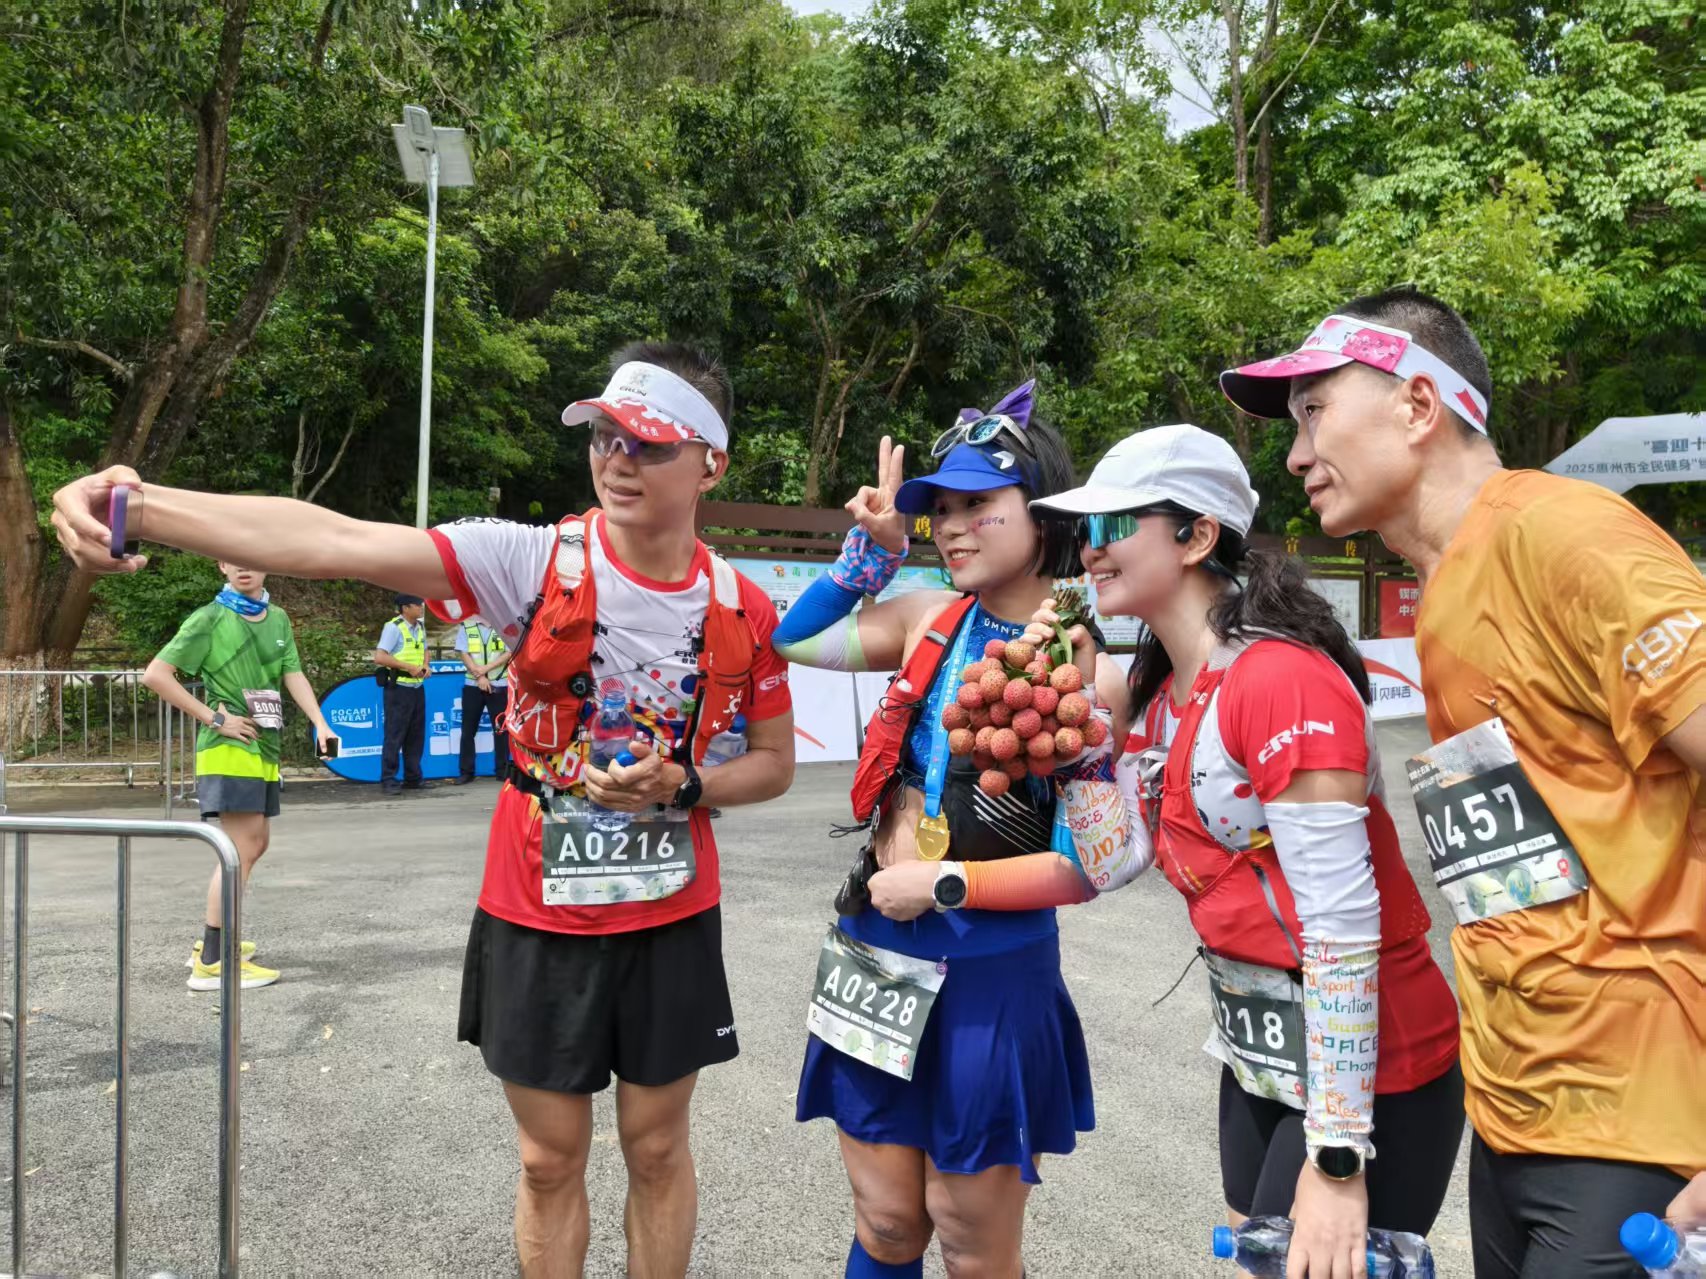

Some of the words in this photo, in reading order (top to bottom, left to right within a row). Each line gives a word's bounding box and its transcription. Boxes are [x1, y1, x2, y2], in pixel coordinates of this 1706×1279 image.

[331, 707, 371, 715] POCARI
[331, 714, 368, 723] SWEAT
[558, 832, 675, 862] A0216
[823, 965, 918, 1027] A0228
